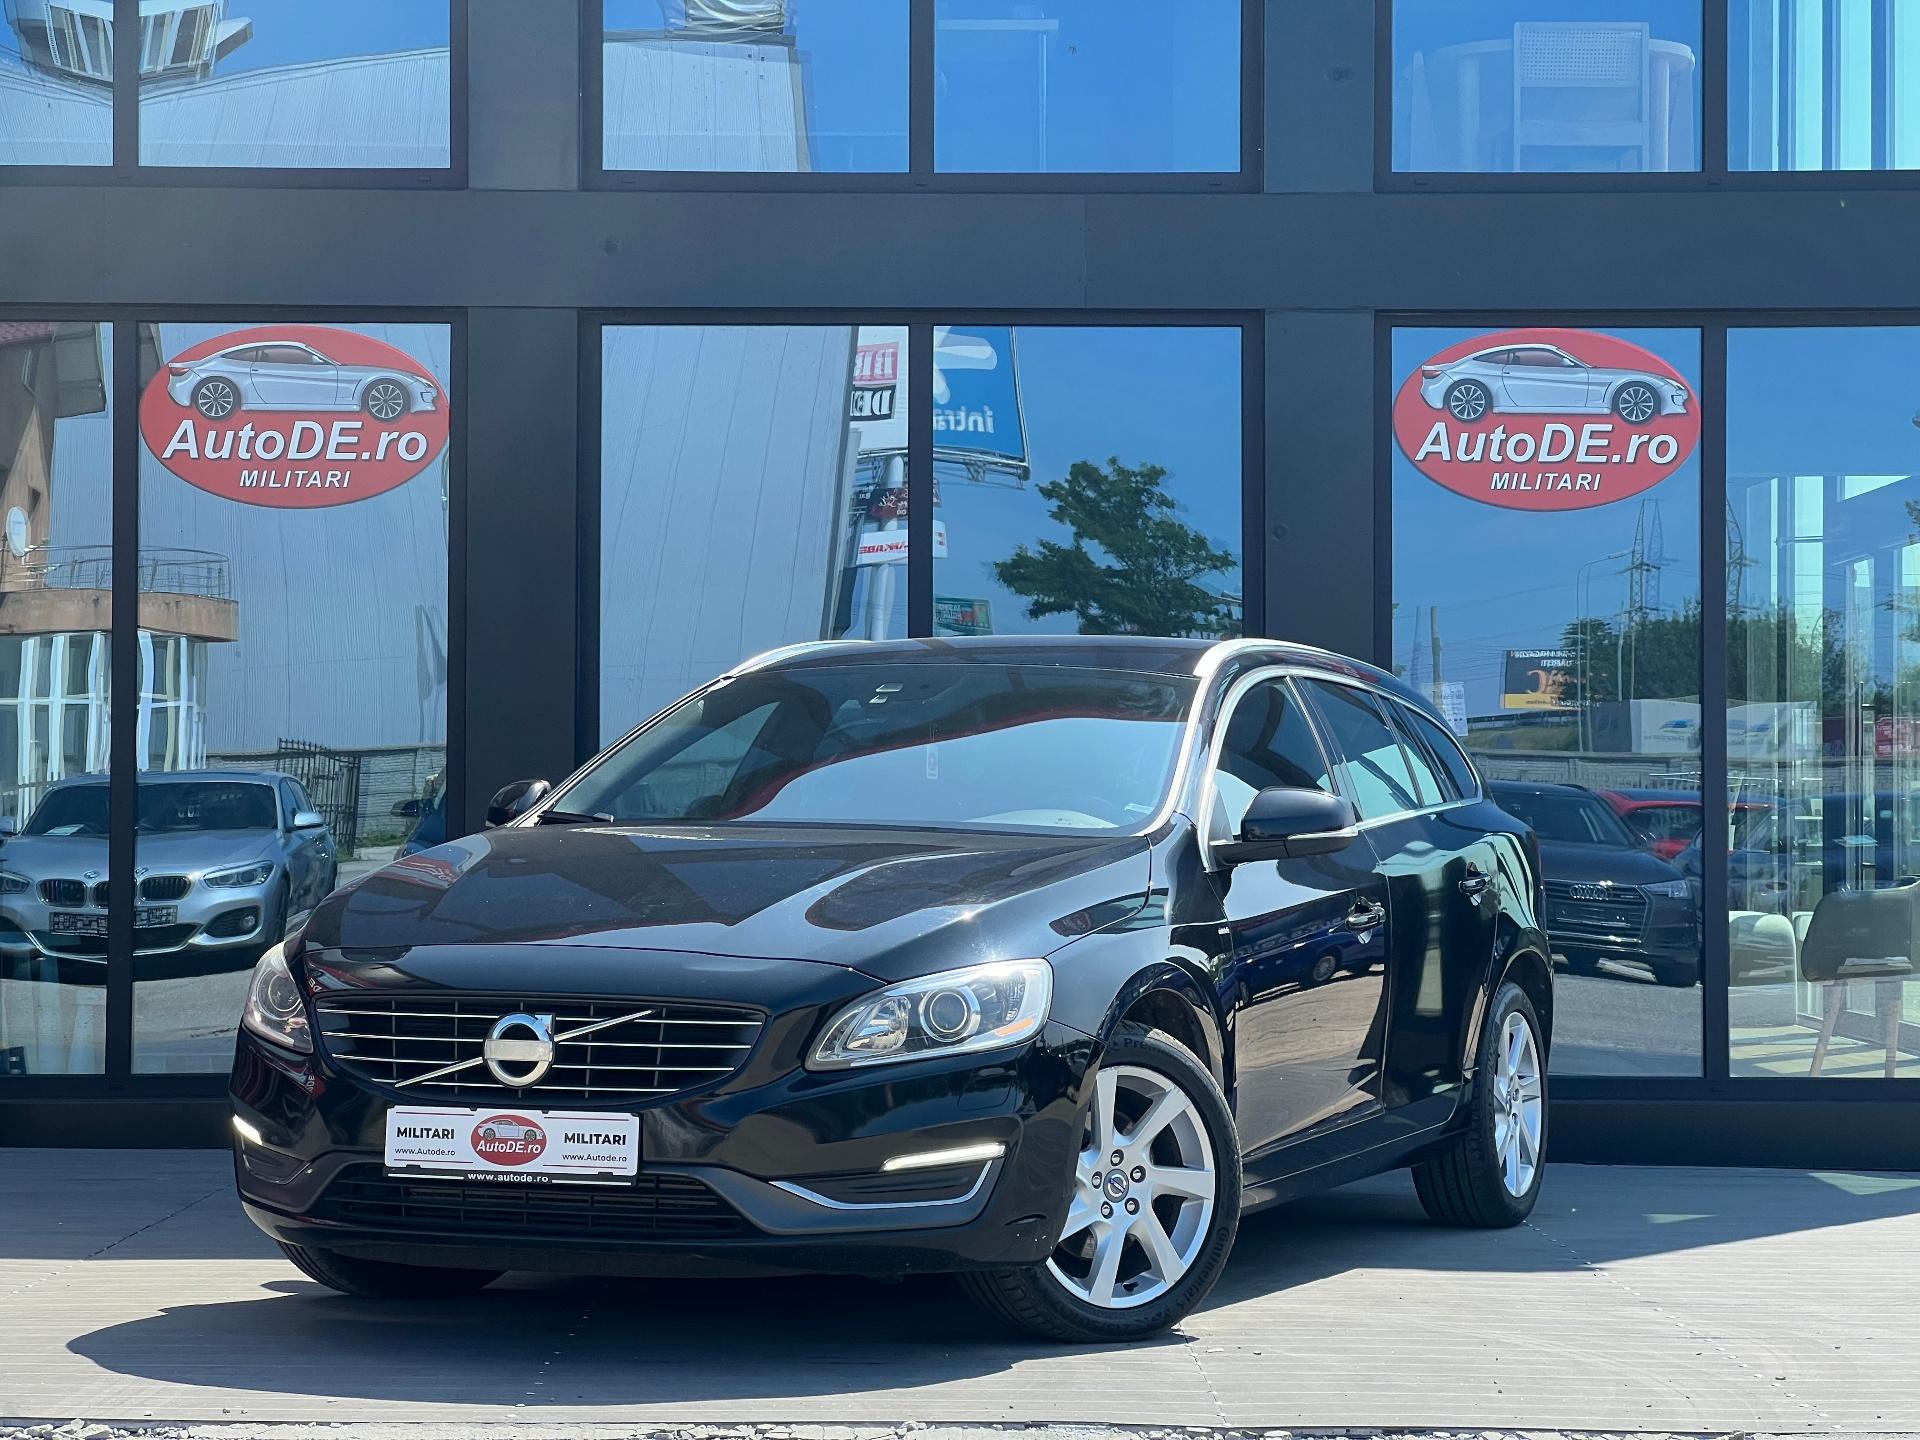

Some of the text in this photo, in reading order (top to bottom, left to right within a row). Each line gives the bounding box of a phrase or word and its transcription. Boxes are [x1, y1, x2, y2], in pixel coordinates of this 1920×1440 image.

[161, 418, 429, 462] AutoDE.ro
[1414, 421, 1680, 464] AutoDE.ro
[239, 469, 352, 488] MILITARI
[1490, 472, 1602, 491] MILITARI
[396, 1126, 455, 1140] MILITARI
[564, 1132, 627, 1146] MILITARI
[394, 1147, 456, 1157] www.Autode.ro
[475, 1140, 542, 1154] AutoDE.ro
[562, 1153, 628, 1163] www.Autode.ro
[467, 1171, 550, 1183] www.autode.ro
